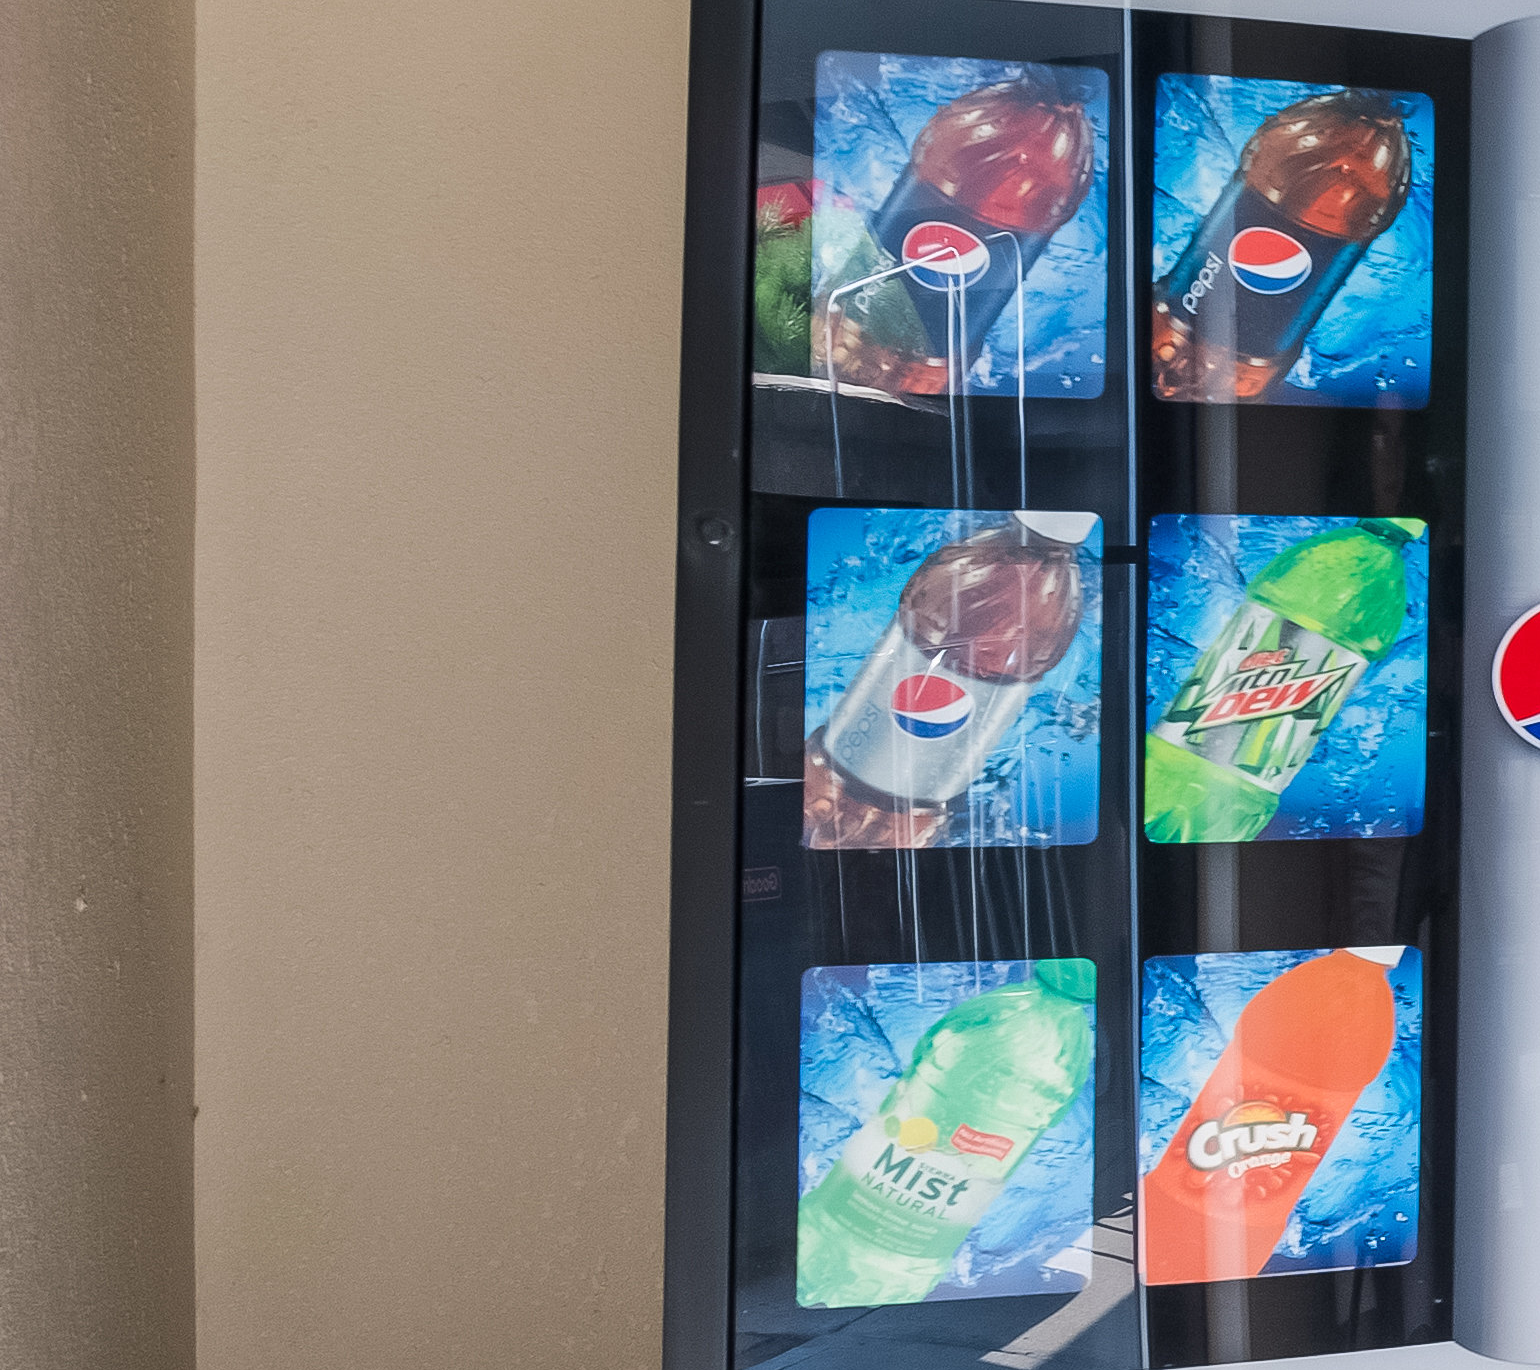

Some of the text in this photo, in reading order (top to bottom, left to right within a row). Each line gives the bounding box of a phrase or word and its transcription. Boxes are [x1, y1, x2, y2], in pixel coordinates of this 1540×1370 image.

[1182, 252, 1223, 314] pepsi
[841, 700, 881, 765] pepsi
[1189, 1112, 1318, 1168] Crush
[861, 1172, 949, 1221] NATURAL
[873, 1143, 969, 1206] Mist
